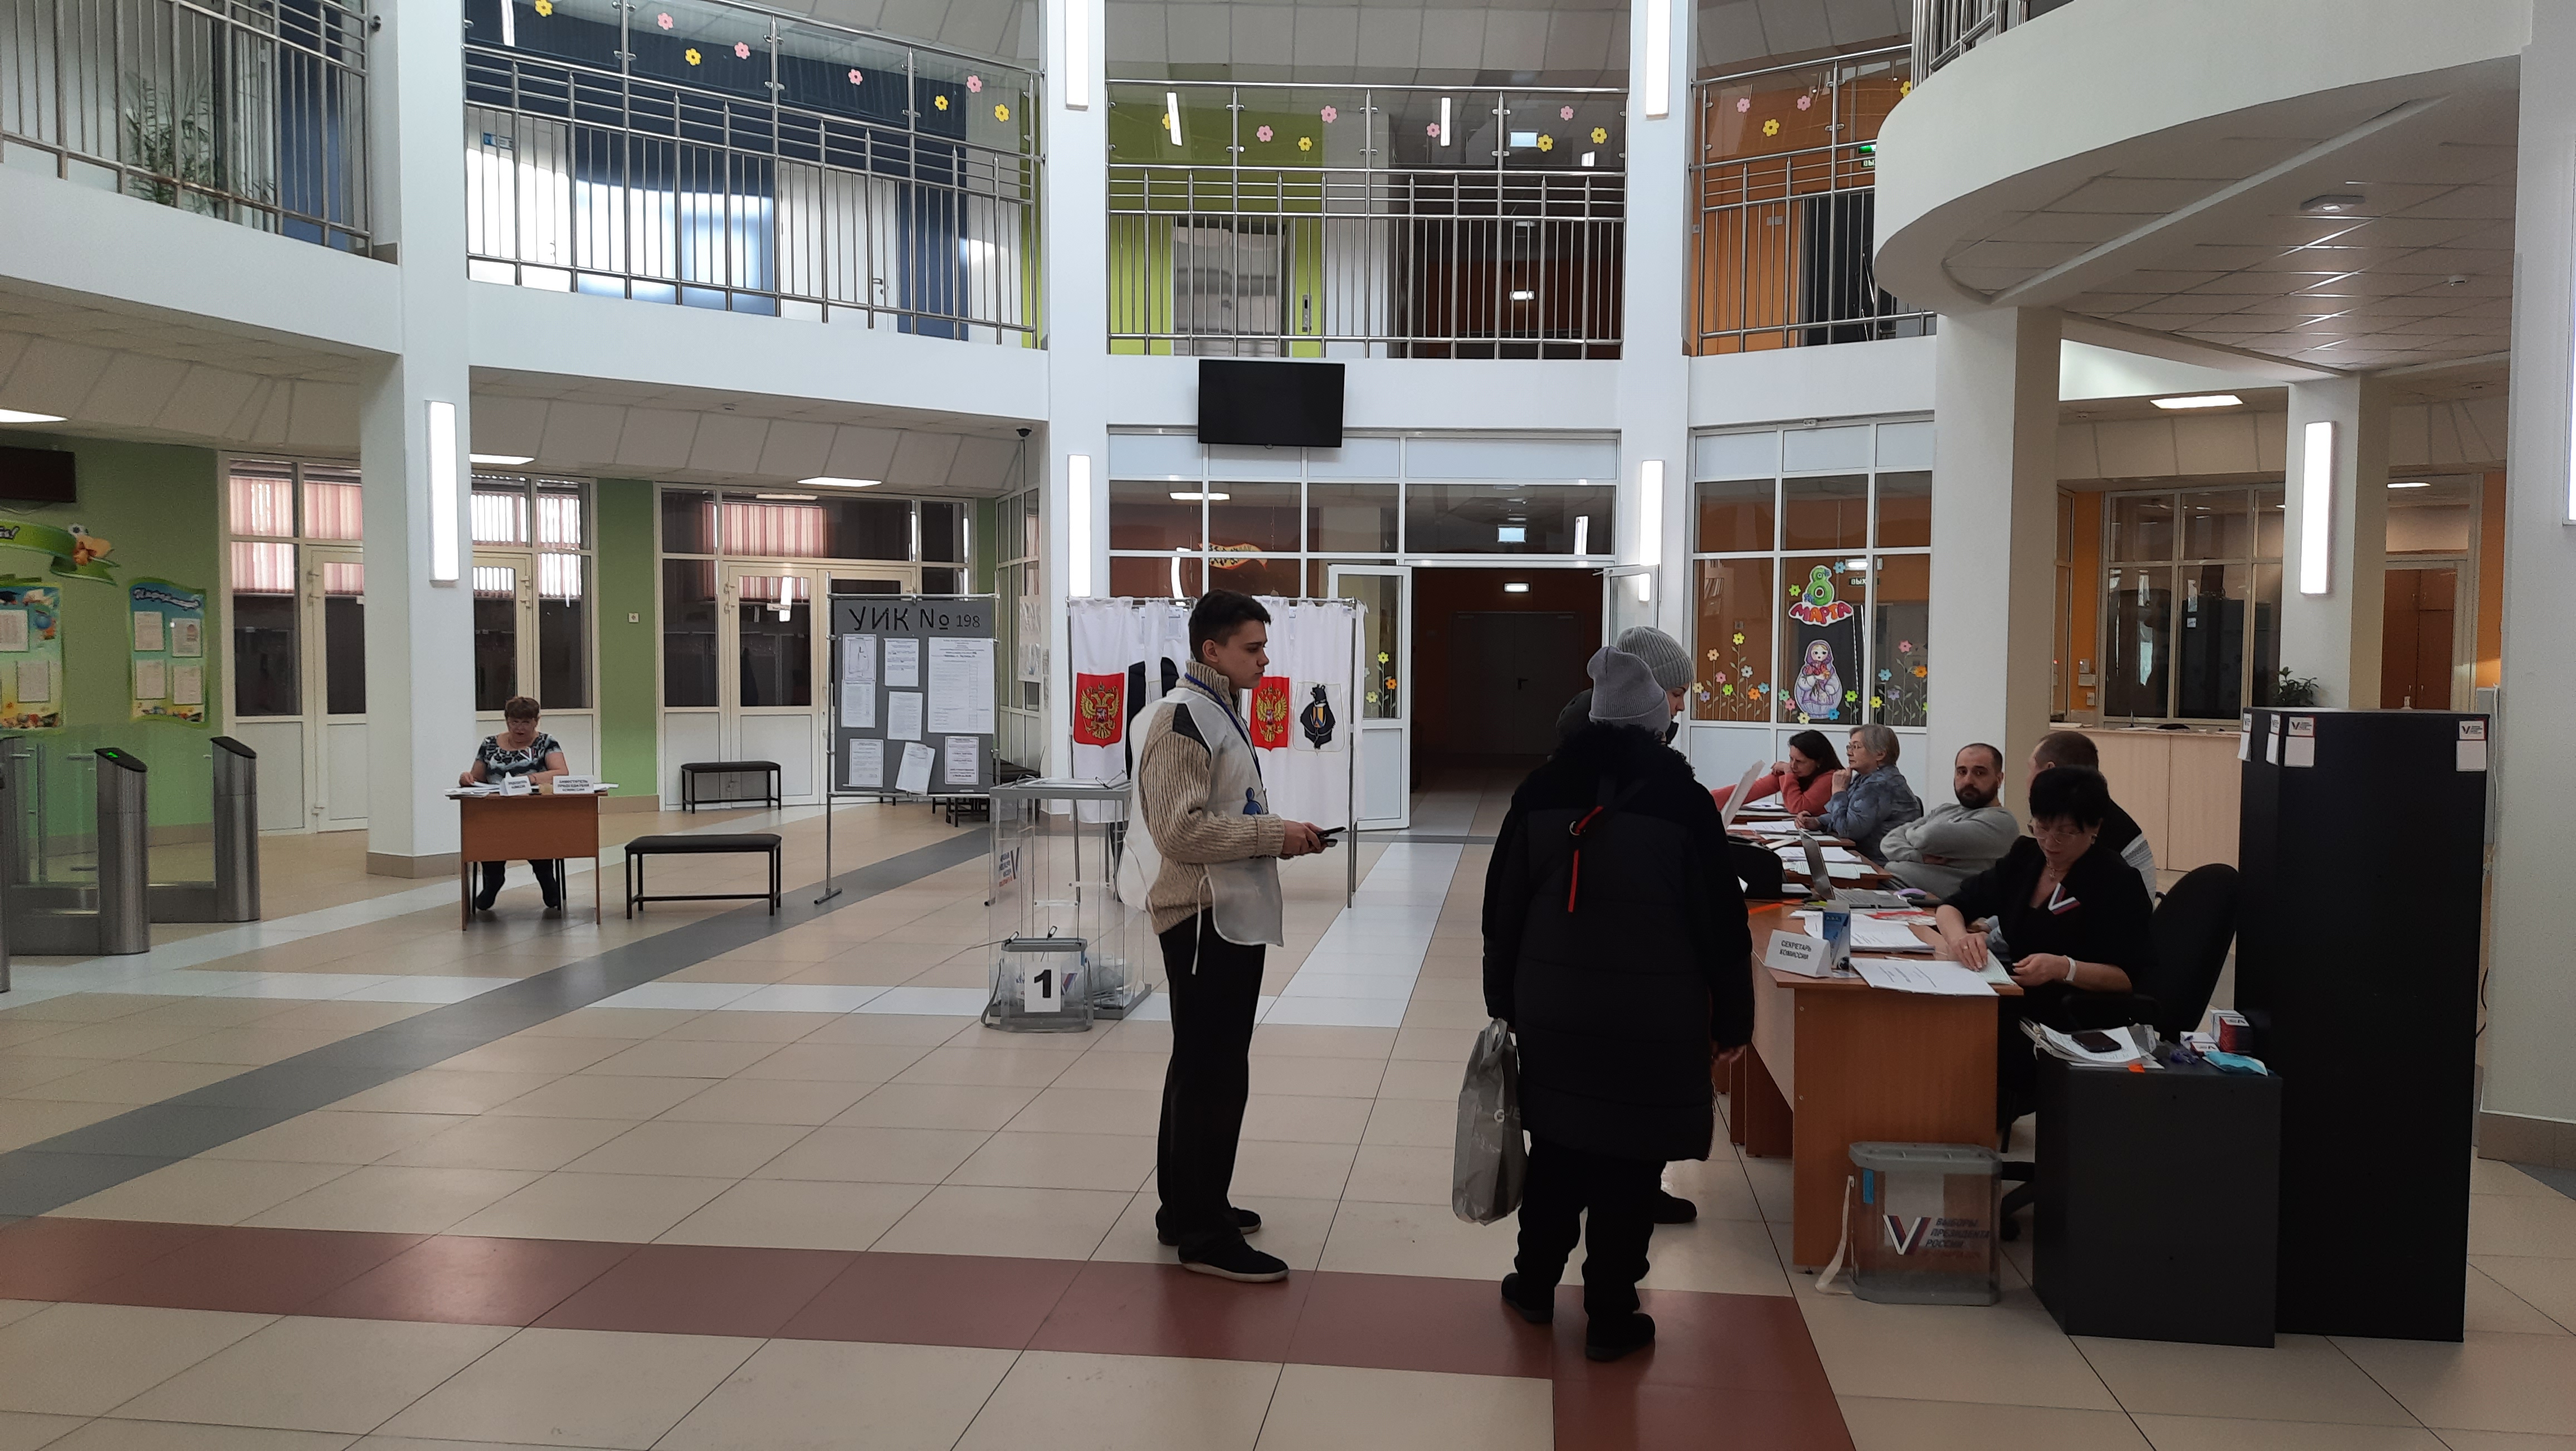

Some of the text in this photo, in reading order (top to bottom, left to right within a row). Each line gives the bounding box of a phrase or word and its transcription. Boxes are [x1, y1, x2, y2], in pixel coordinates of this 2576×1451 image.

[1804, 566, 1833, 606] 8
[848, 606, 910, 631] УИК
[956, 614, 980, 628] 198
[1790, 602, 1852, 625] МАРТА
[1033, 968, 1052, 999] 1
